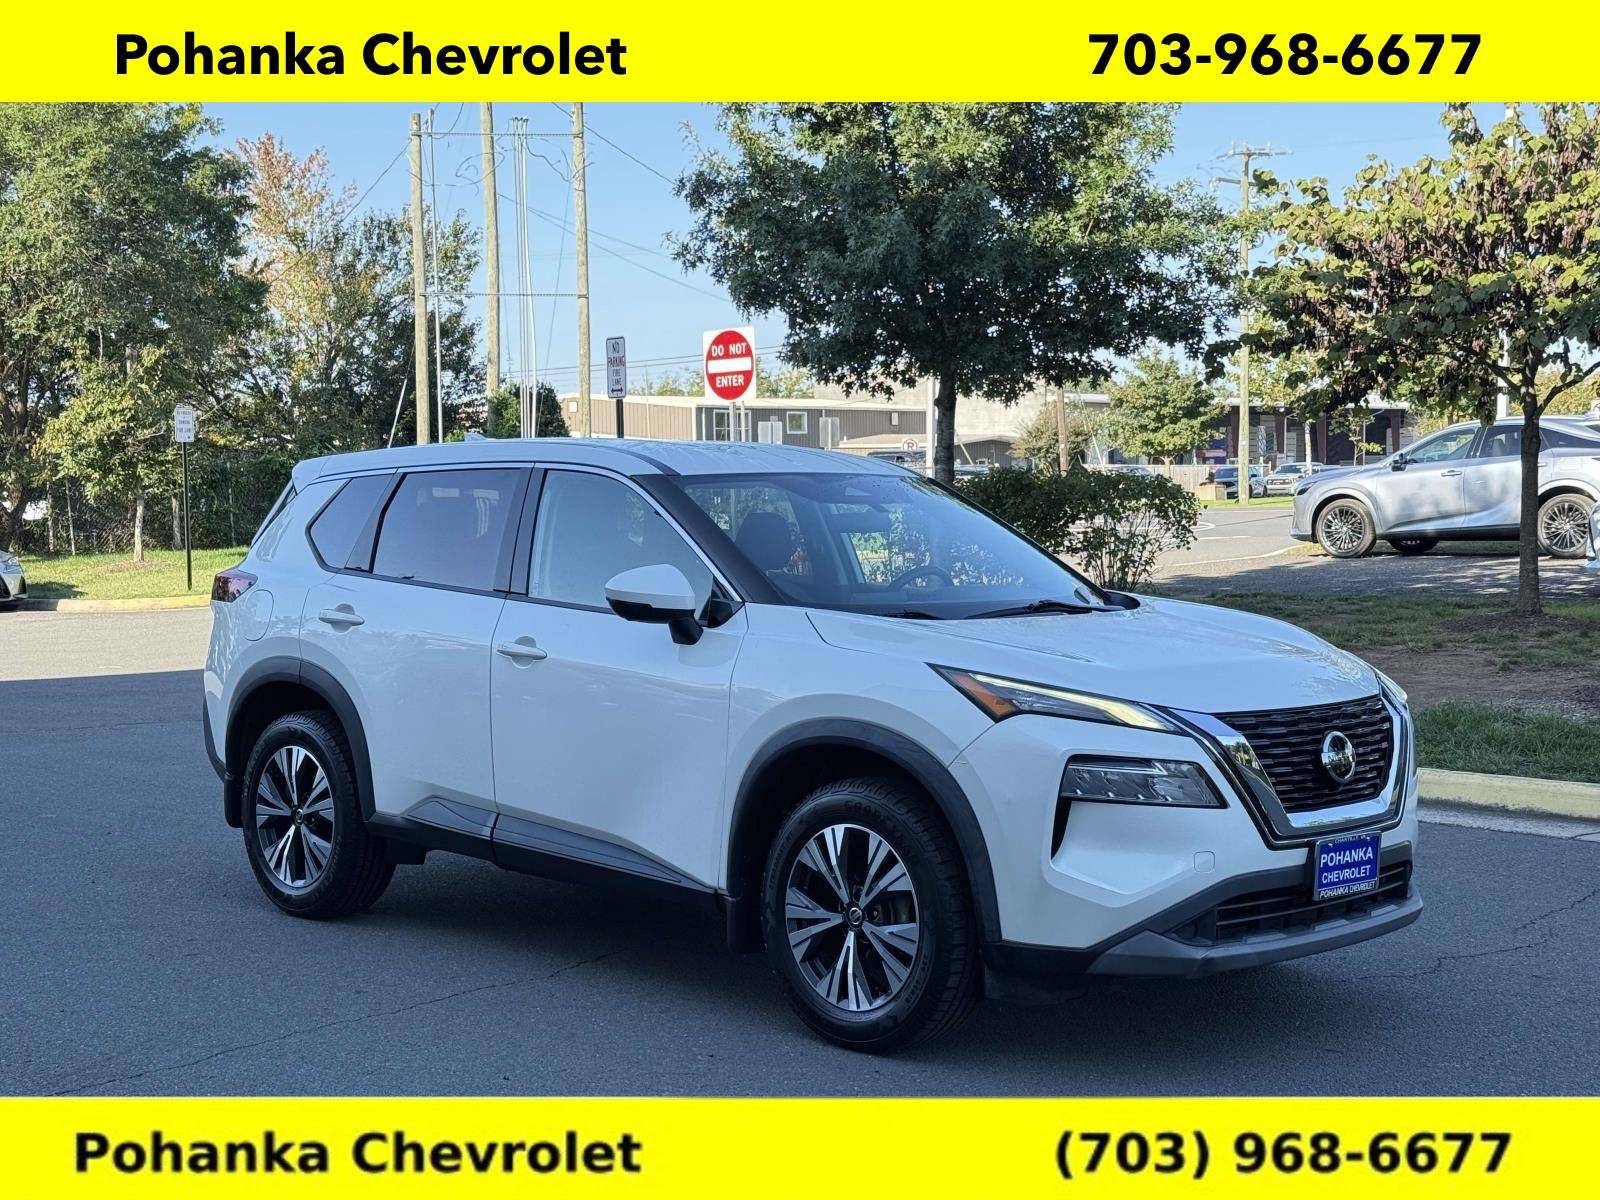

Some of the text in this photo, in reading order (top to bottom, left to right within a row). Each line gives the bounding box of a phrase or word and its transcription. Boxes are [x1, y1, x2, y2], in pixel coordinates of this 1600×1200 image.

[711, 342, 747, 357] DO NOT
[716, 374, 745, 388] ENTER
[1320, 846, 1373, 868] POHANKA
[1321, 865, 1371, 884] CHEVROLET
[1320, 881, 1375, 899] POHANKA CHEVROLET
